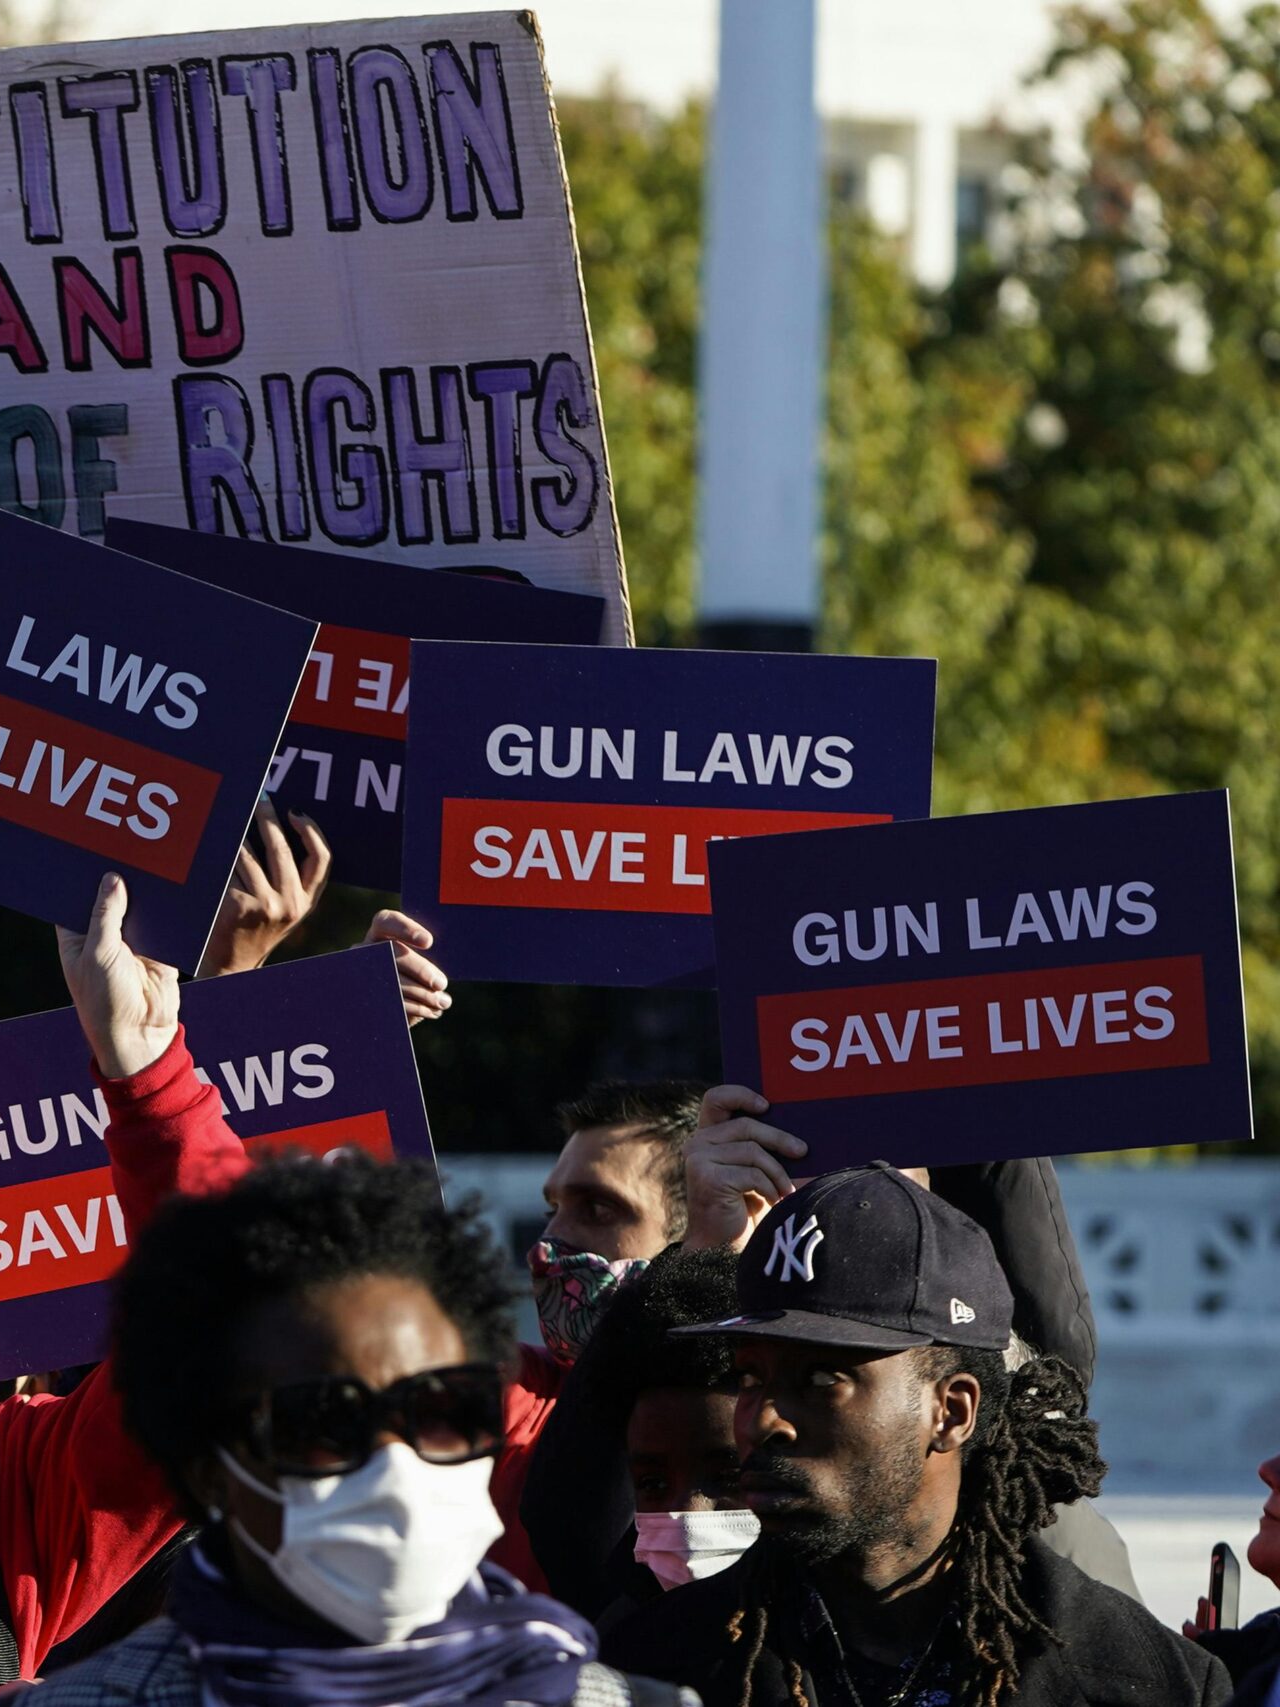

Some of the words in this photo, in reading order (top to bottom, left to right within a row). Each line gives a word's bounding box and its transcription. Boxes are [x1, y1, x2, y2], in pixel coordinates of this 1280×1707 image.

[174, 351, 601, 548] RIGHTS
[6, 614, 208, 731] LAWS
[485, 724, 635, 780] GUN
[662, 730, 855, 789] LAWS
[469, 825, 646, 885] SAVE
[791, 901, 940, 967] GUN
[965, 881, 1157, 951] LAWS
[789, 1006, 963, 1073] SAVE
[987, 986, 1175, 1055] LIVES
